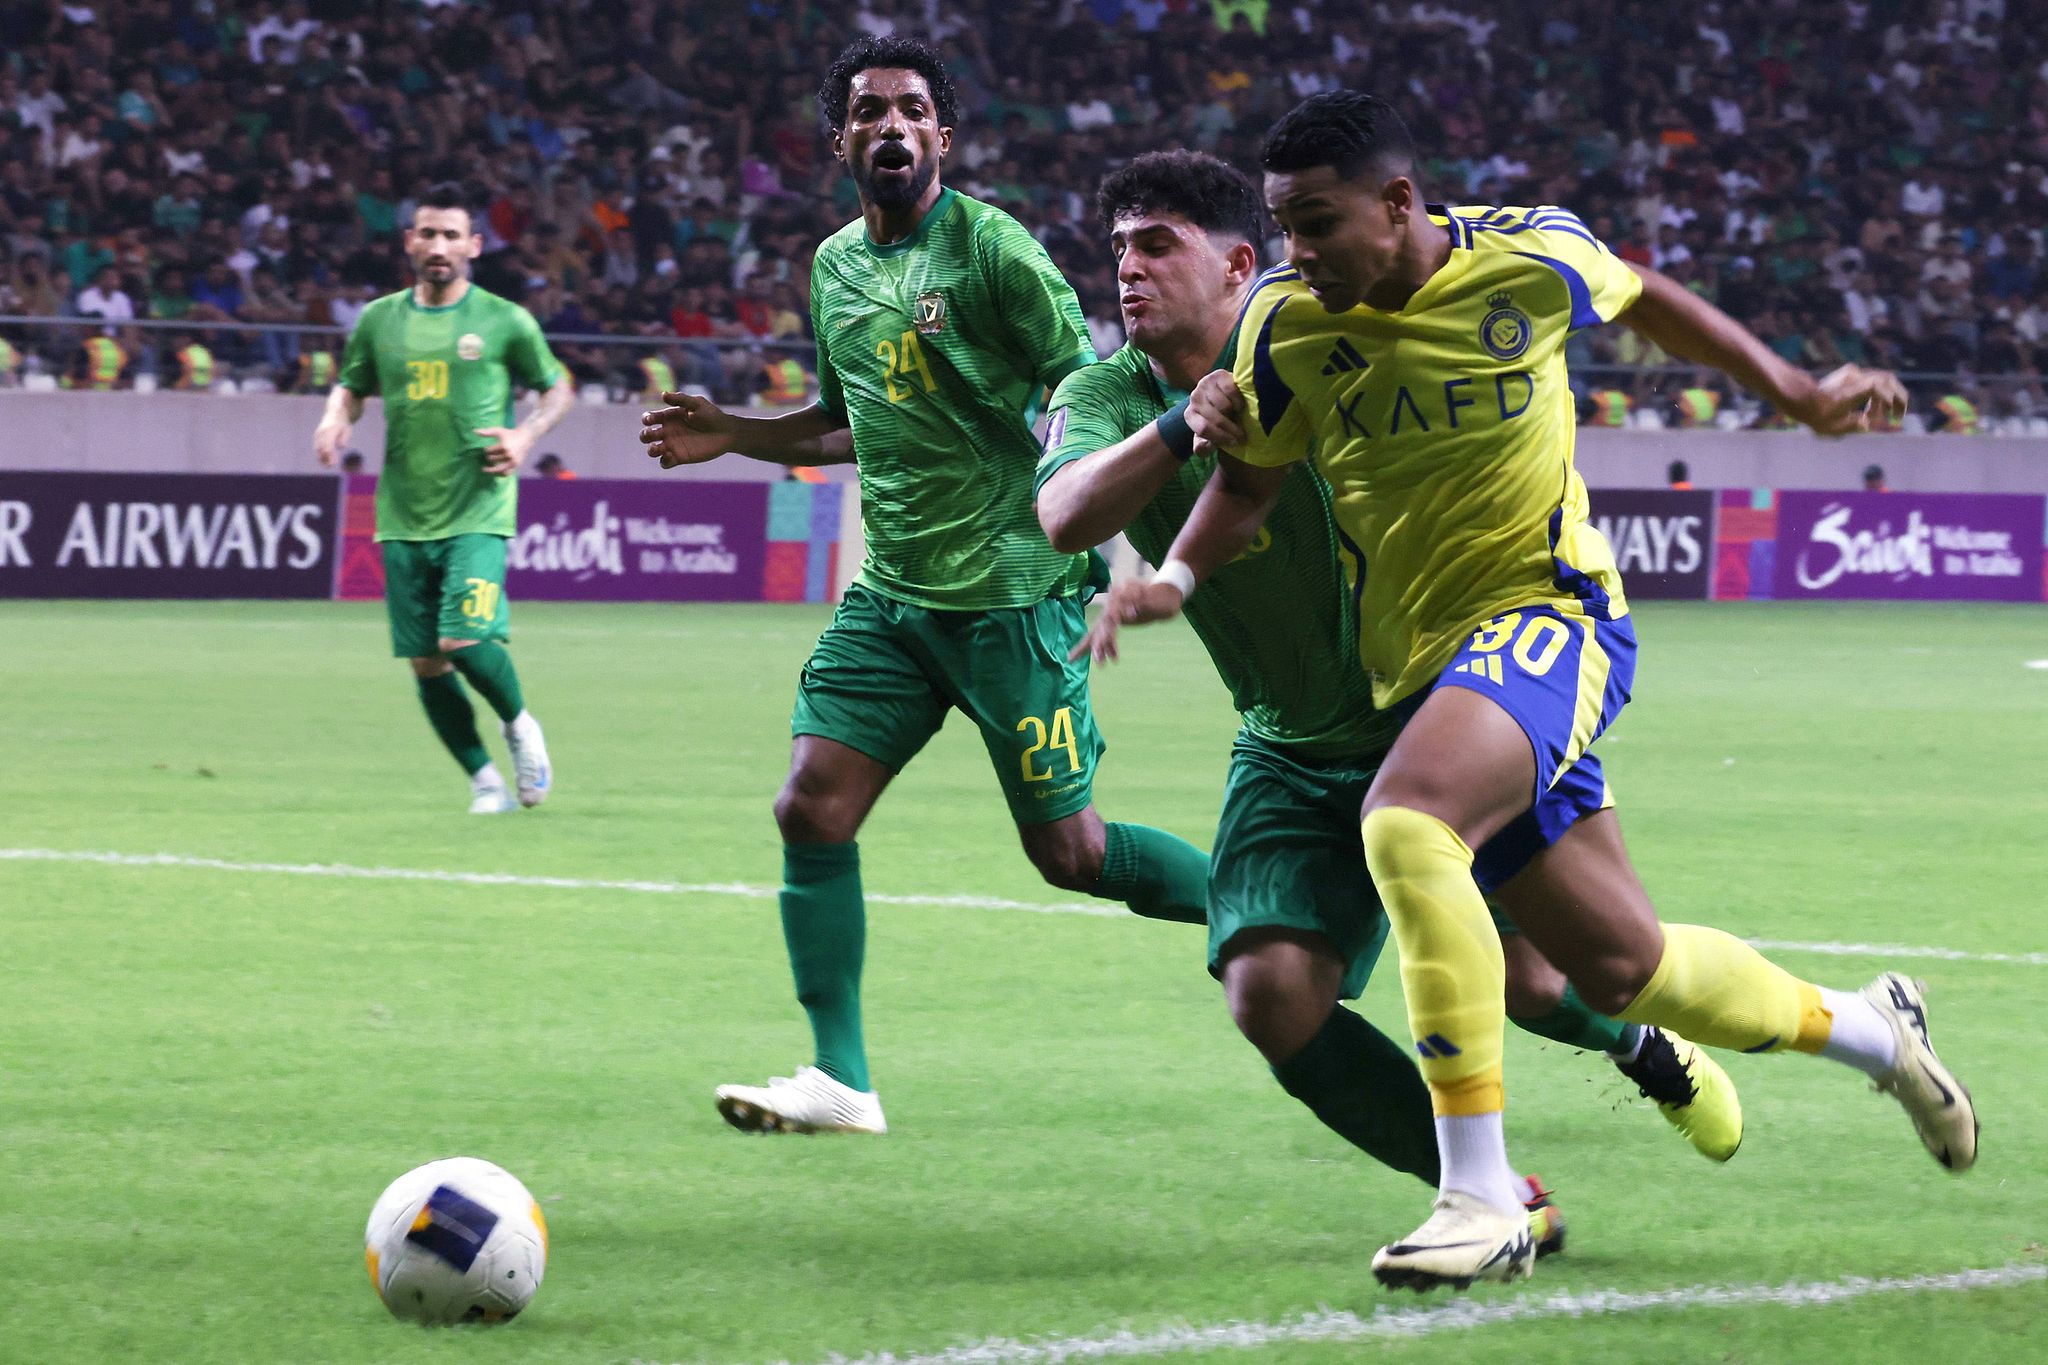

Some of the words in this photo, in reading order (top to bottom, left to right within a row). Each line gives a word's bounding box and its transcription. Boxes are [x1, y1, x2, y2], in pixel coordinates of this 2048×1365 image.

[408, 361, 449, 400] 30
[876, 330, 937, 403] 24
[1334, 371, 1534, 439] KAFD
[56, 502, 322, 569] AIRWAYS
[463, 578, 499, 621] 30
[1017, 707, 1081, 782] 24
